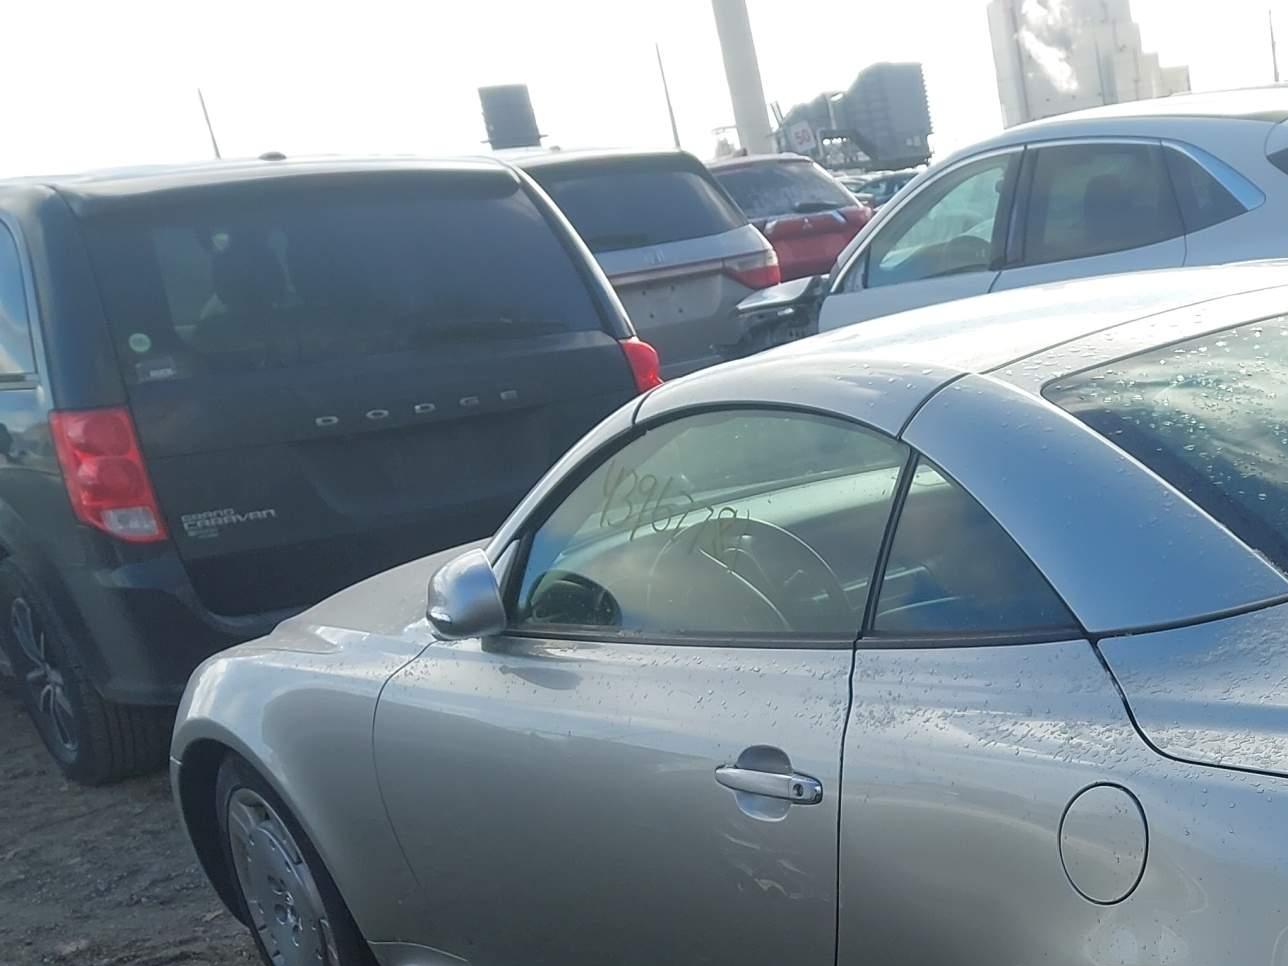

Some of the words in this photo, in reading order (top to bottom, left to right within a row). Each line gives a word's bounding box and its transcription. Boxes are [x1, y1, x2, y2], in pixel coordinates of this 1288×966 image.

[315, 388, 518, 426] DODGE
[181, 508, 234, 523] GRAND
[183, 509, 276, 531] CARAVAN
